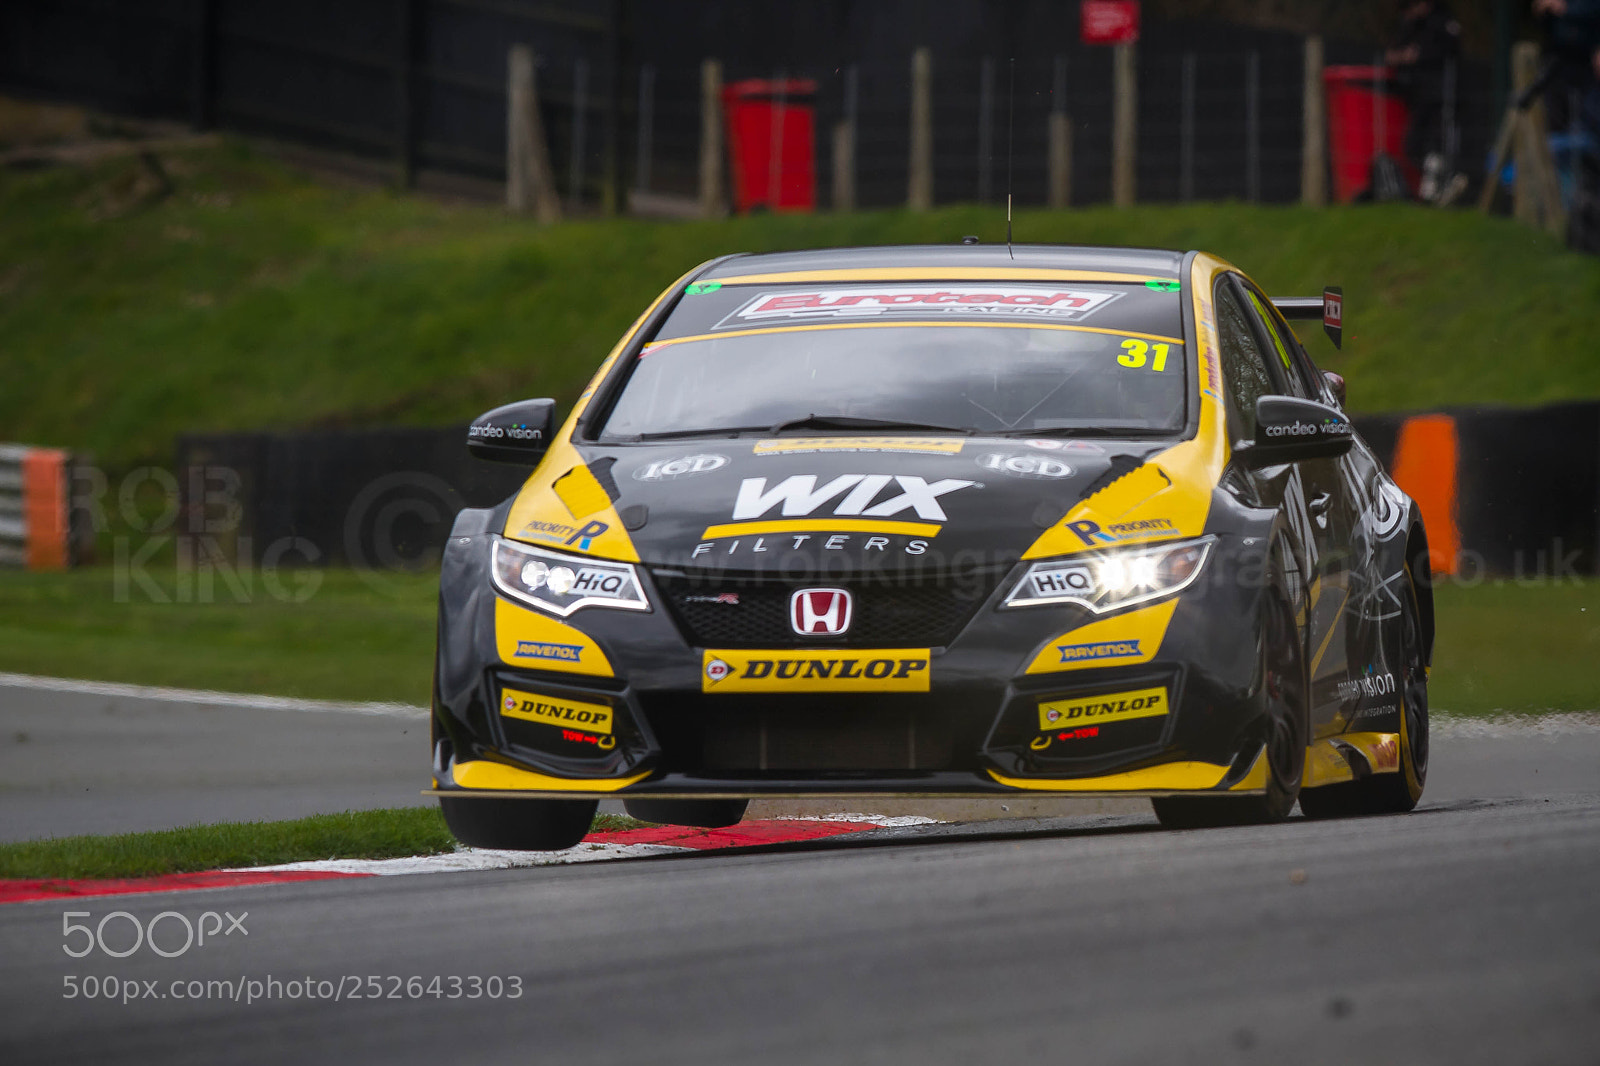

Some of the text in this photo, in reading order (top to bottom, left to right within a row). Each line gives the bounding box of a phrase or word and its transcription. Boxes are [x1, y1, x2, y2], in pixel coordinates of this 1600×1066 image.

[753, 291, 1090, 313] Eurotech
[943, 306, 1074, 317] RACING
[1117, 339, 1170, 372] 31
[469, 423, 542, 439] candeo vision
[1265, 419, 1352, 437] candeo vision
[732, 474, 976, 521] WIX
[1108, 518, 1173, 534] PRIORITY
[691, 534, 930, 559] FILTERS
[573, 572, 622, 594] HiQ
[1035, 572, 1089, 592] HiQ
[519, 643, 578, 660] RAVENOL
[1064, 643, 1137, 659] RAVENOL
[740, 659, 927, 679] DUNLOP
[519, 700, 608, 725] DUNLOP
[1066, 695, 1160, 719] DUNLOP
[562, 729, 585, 743] TOW
[1074, 726, 1099, 740] TOW
